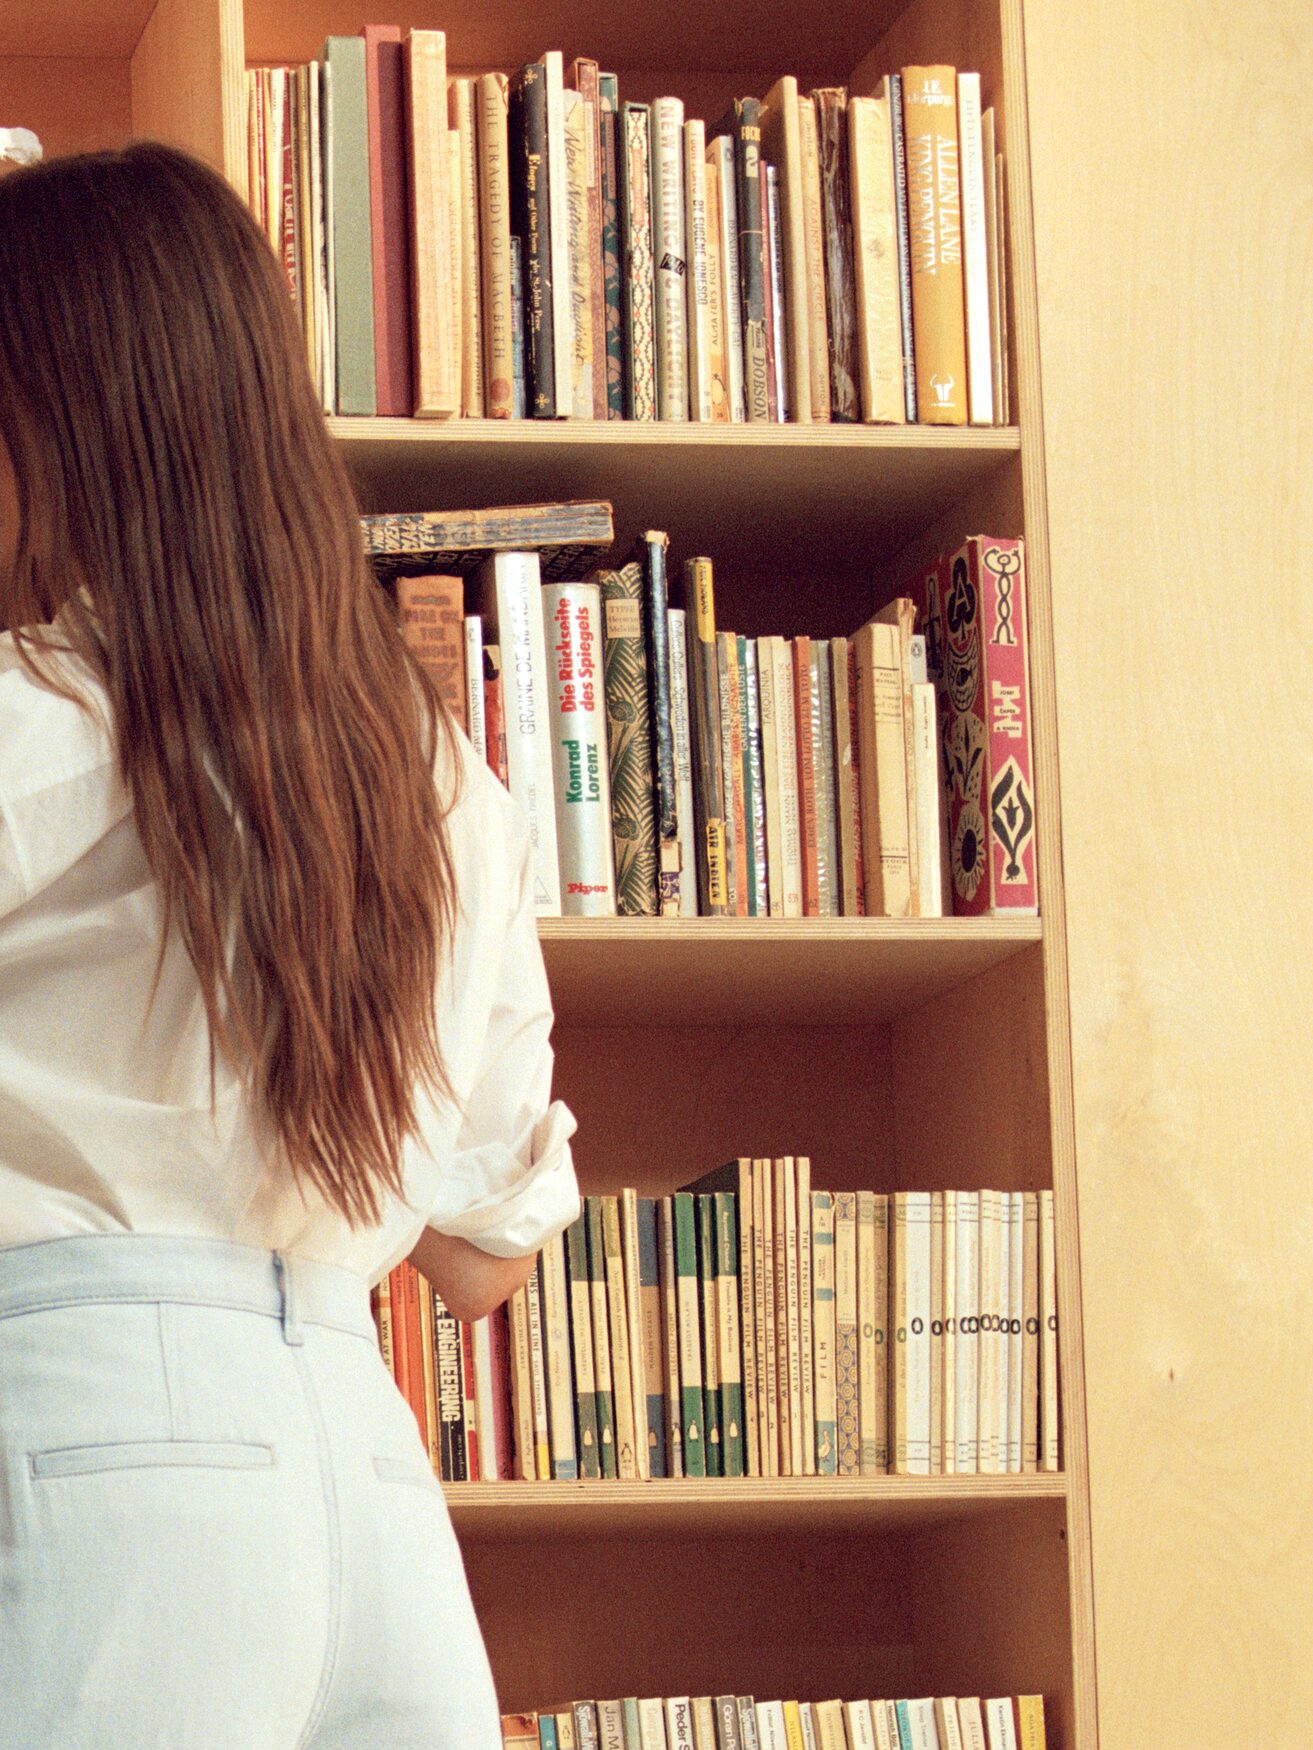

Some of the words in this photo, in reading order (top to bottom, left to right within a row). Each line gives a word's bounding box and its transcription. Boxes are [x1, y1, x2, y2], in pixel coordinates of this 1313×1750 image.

[485, 95, 498, 126] THE
[488, 143, 500, 227] TRAGEDY
[937, 136, 959, 205] ALLEN
[491, 237, 501, 258] OF
[938, 209, 960, 264] LANE
[492, 273, 505, 359] MACBETH
[752, 356, 766, 420] DOBSON
[555, 598, 572, 681] Rückseite
[576, 607, 595, 678] Spiegels
[561, 684, 577, 713] Die
[581, 682, 595, 711] des
[562, 740, 583, 803] Konrad
[587, 744, 600, 802] Lorenz
[709, 827, 719, 848] AIR
[711, 855, 721, 898] INDIEN
[437, 1319, 461, 1422] ENGINEERING
[819, 1342, 827, 1379] FILM
[604, 1706, 617, 1731] Jan
[675, 1703, 688, 1740] Peder
[723, 1704, 736, 1736] Göran
